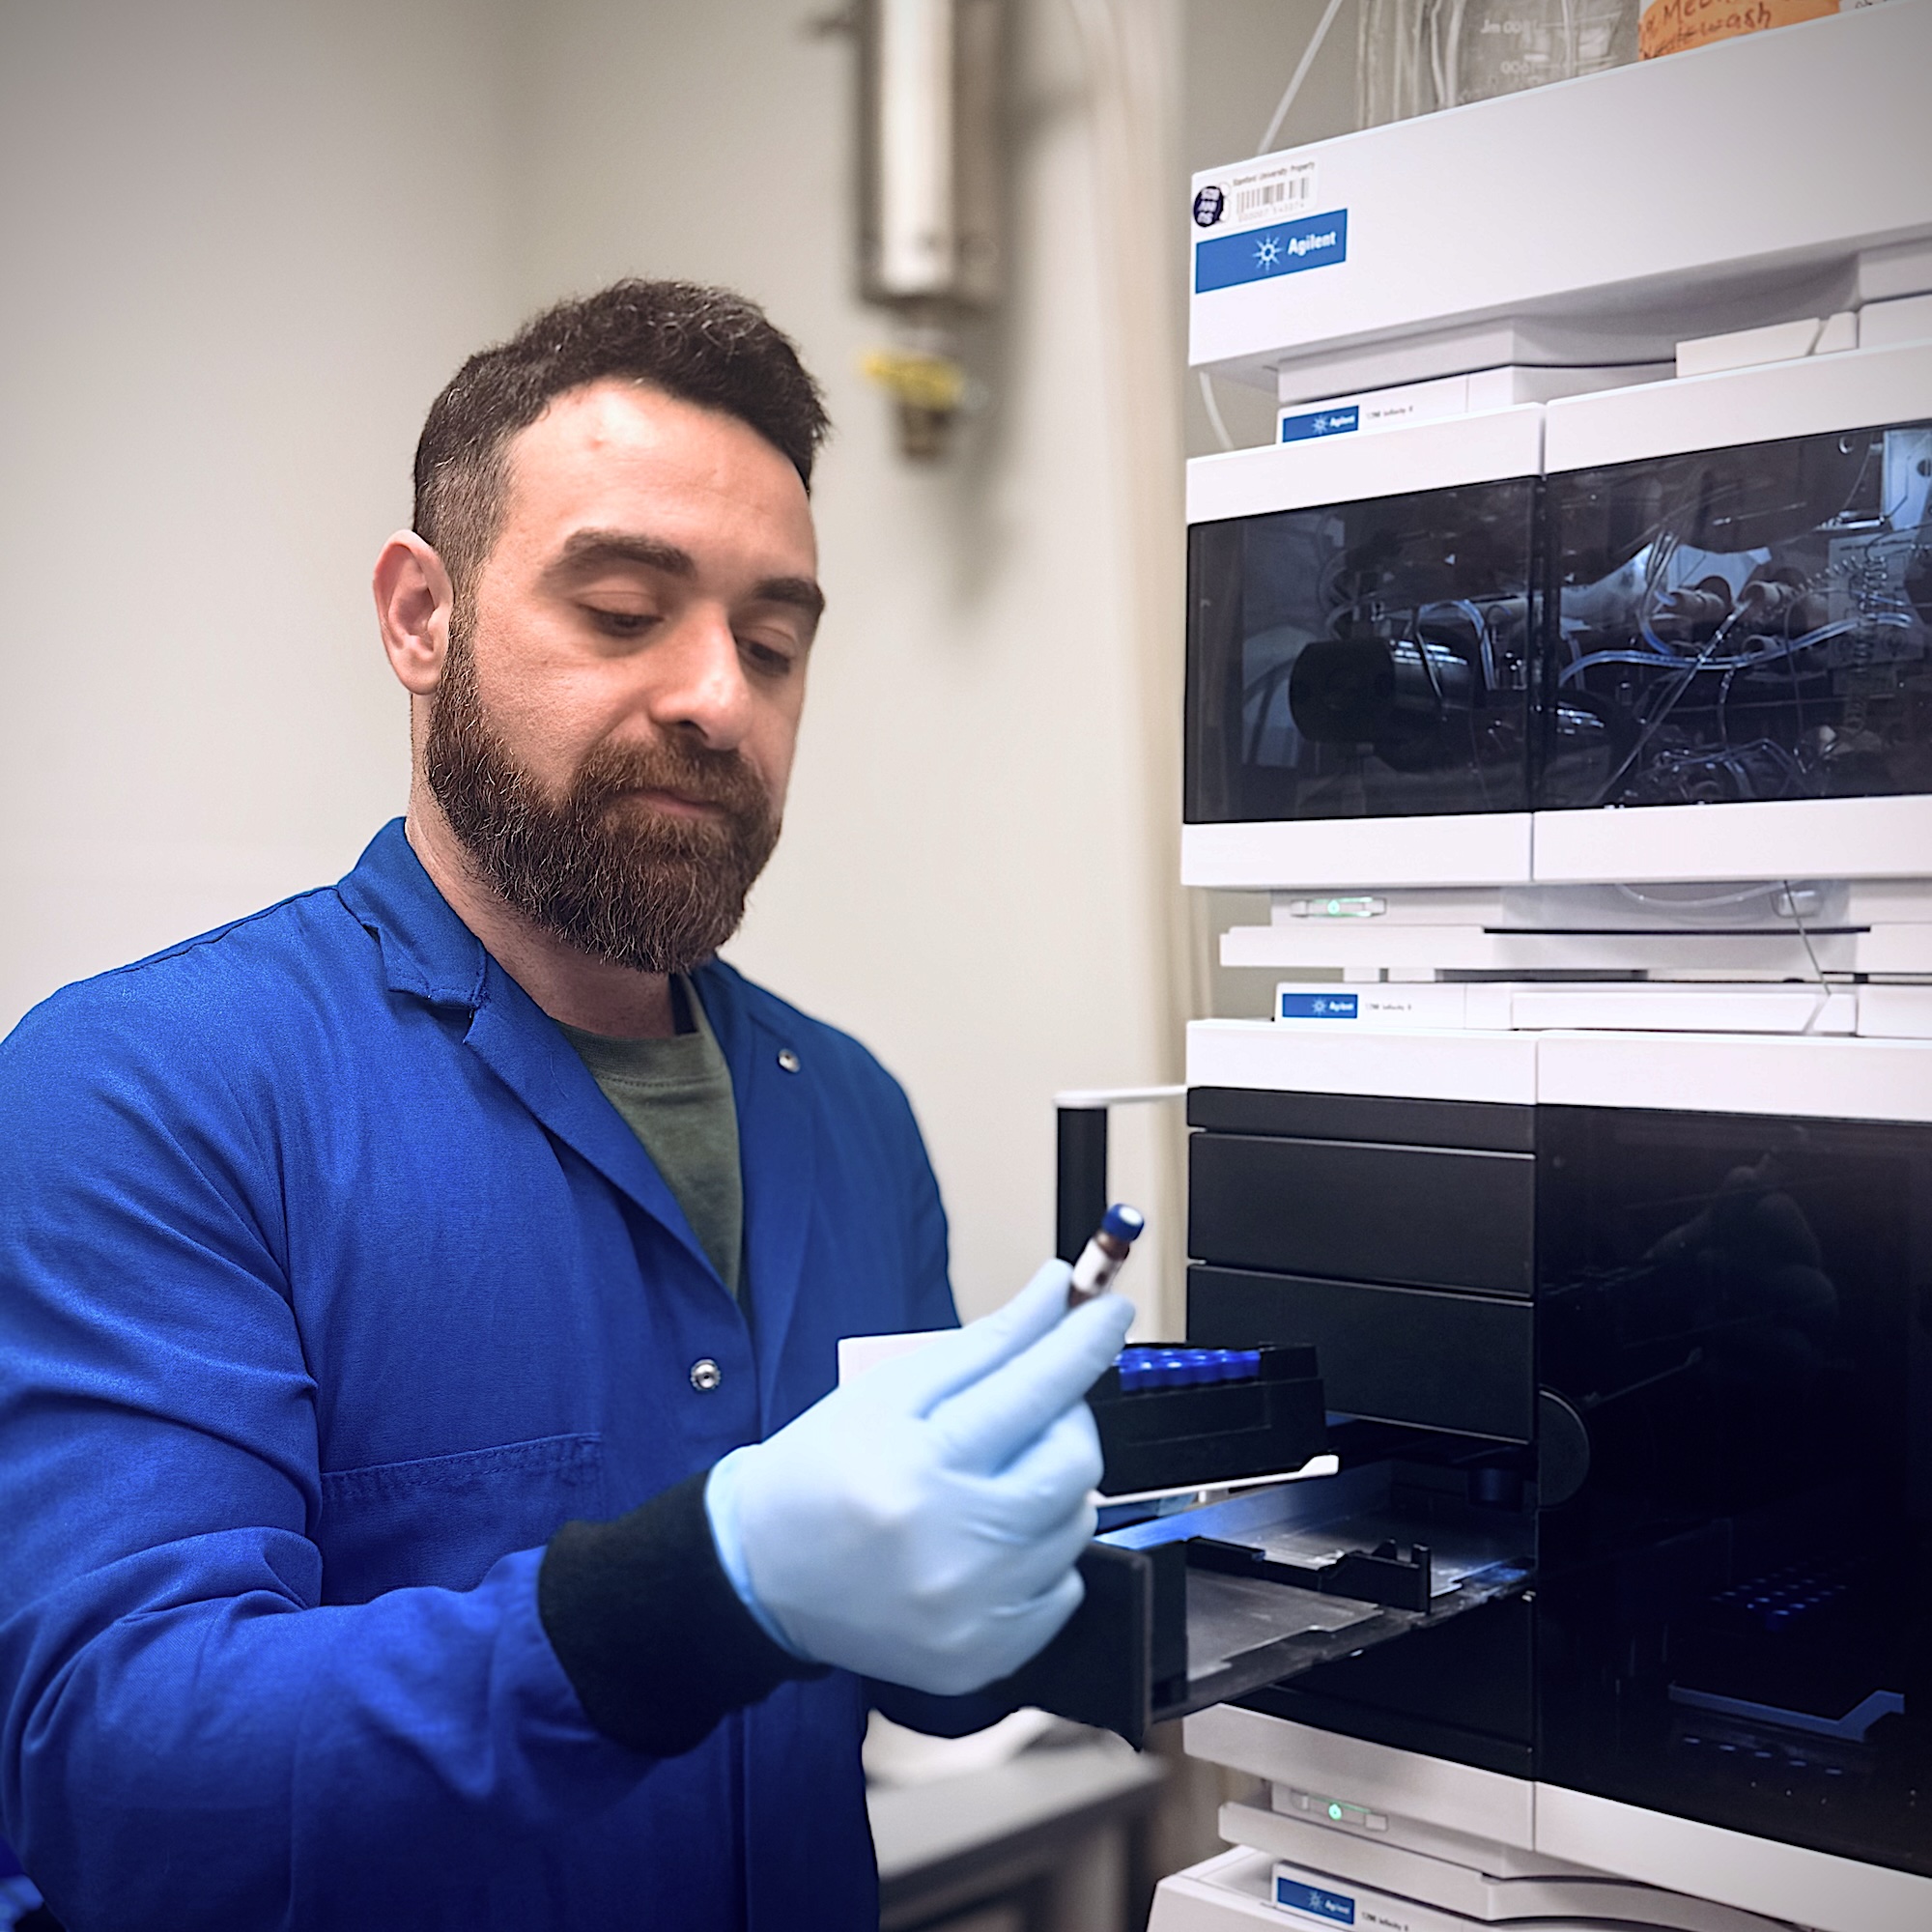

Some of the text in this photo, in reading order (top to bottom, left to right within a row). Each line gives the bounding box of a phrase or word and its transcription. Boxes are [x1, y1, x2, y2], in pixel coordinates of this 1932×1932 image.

[1288, 231, 1337, 256] Agilent
[1329, 413, 1355, 428] Agilent
[1329, 1000, 1354, 1012] Agilent
[1324, 1898, 1350, 1916] Agilent
